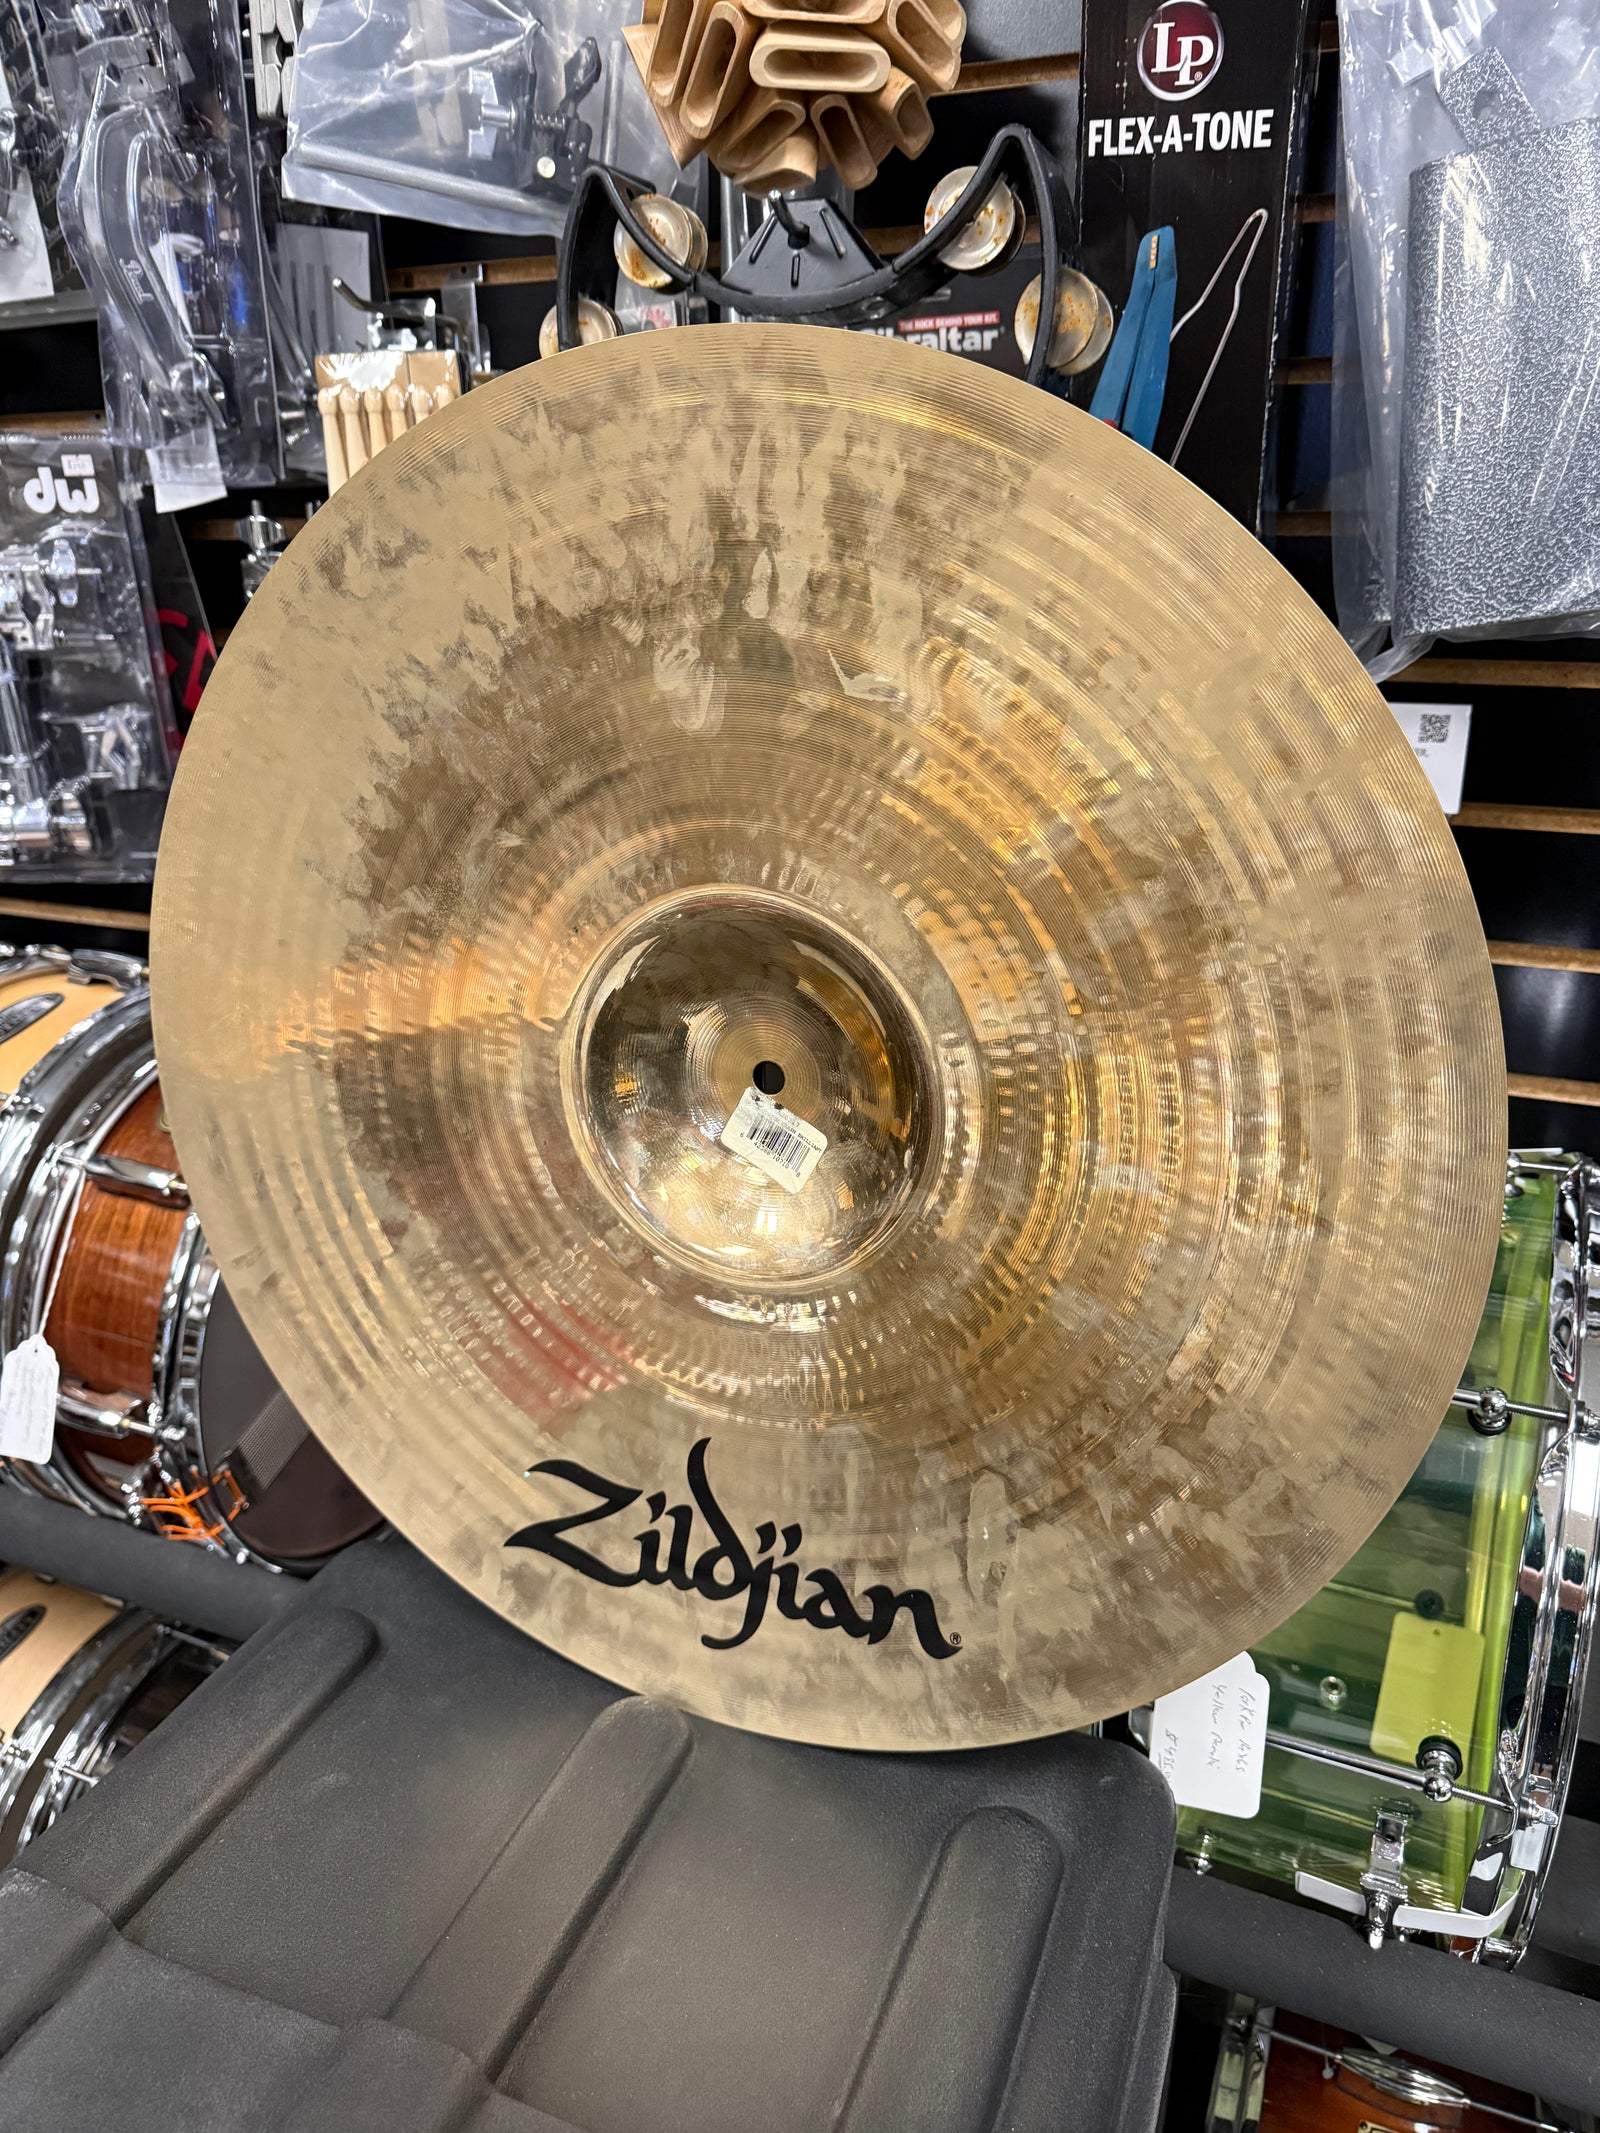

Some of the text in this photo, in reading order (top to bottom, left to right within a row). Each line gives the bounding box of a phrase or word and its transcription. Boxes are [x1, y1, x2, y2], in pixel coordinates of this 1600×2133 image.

[1151, 22, 1214, 86] LP
[1088, 109, 1274, 157] FLEX-A-TONE
[915, 317, 934, 330] ROCK
[936, 314, 963, 327] BEHIND
[965, 312, 983, 325] YOUR
[23, 466, 100, 514] dw
[797, 1133, 822, 1153] BRILLIANT
[503, 1437, 963, 1660] Zildjian
